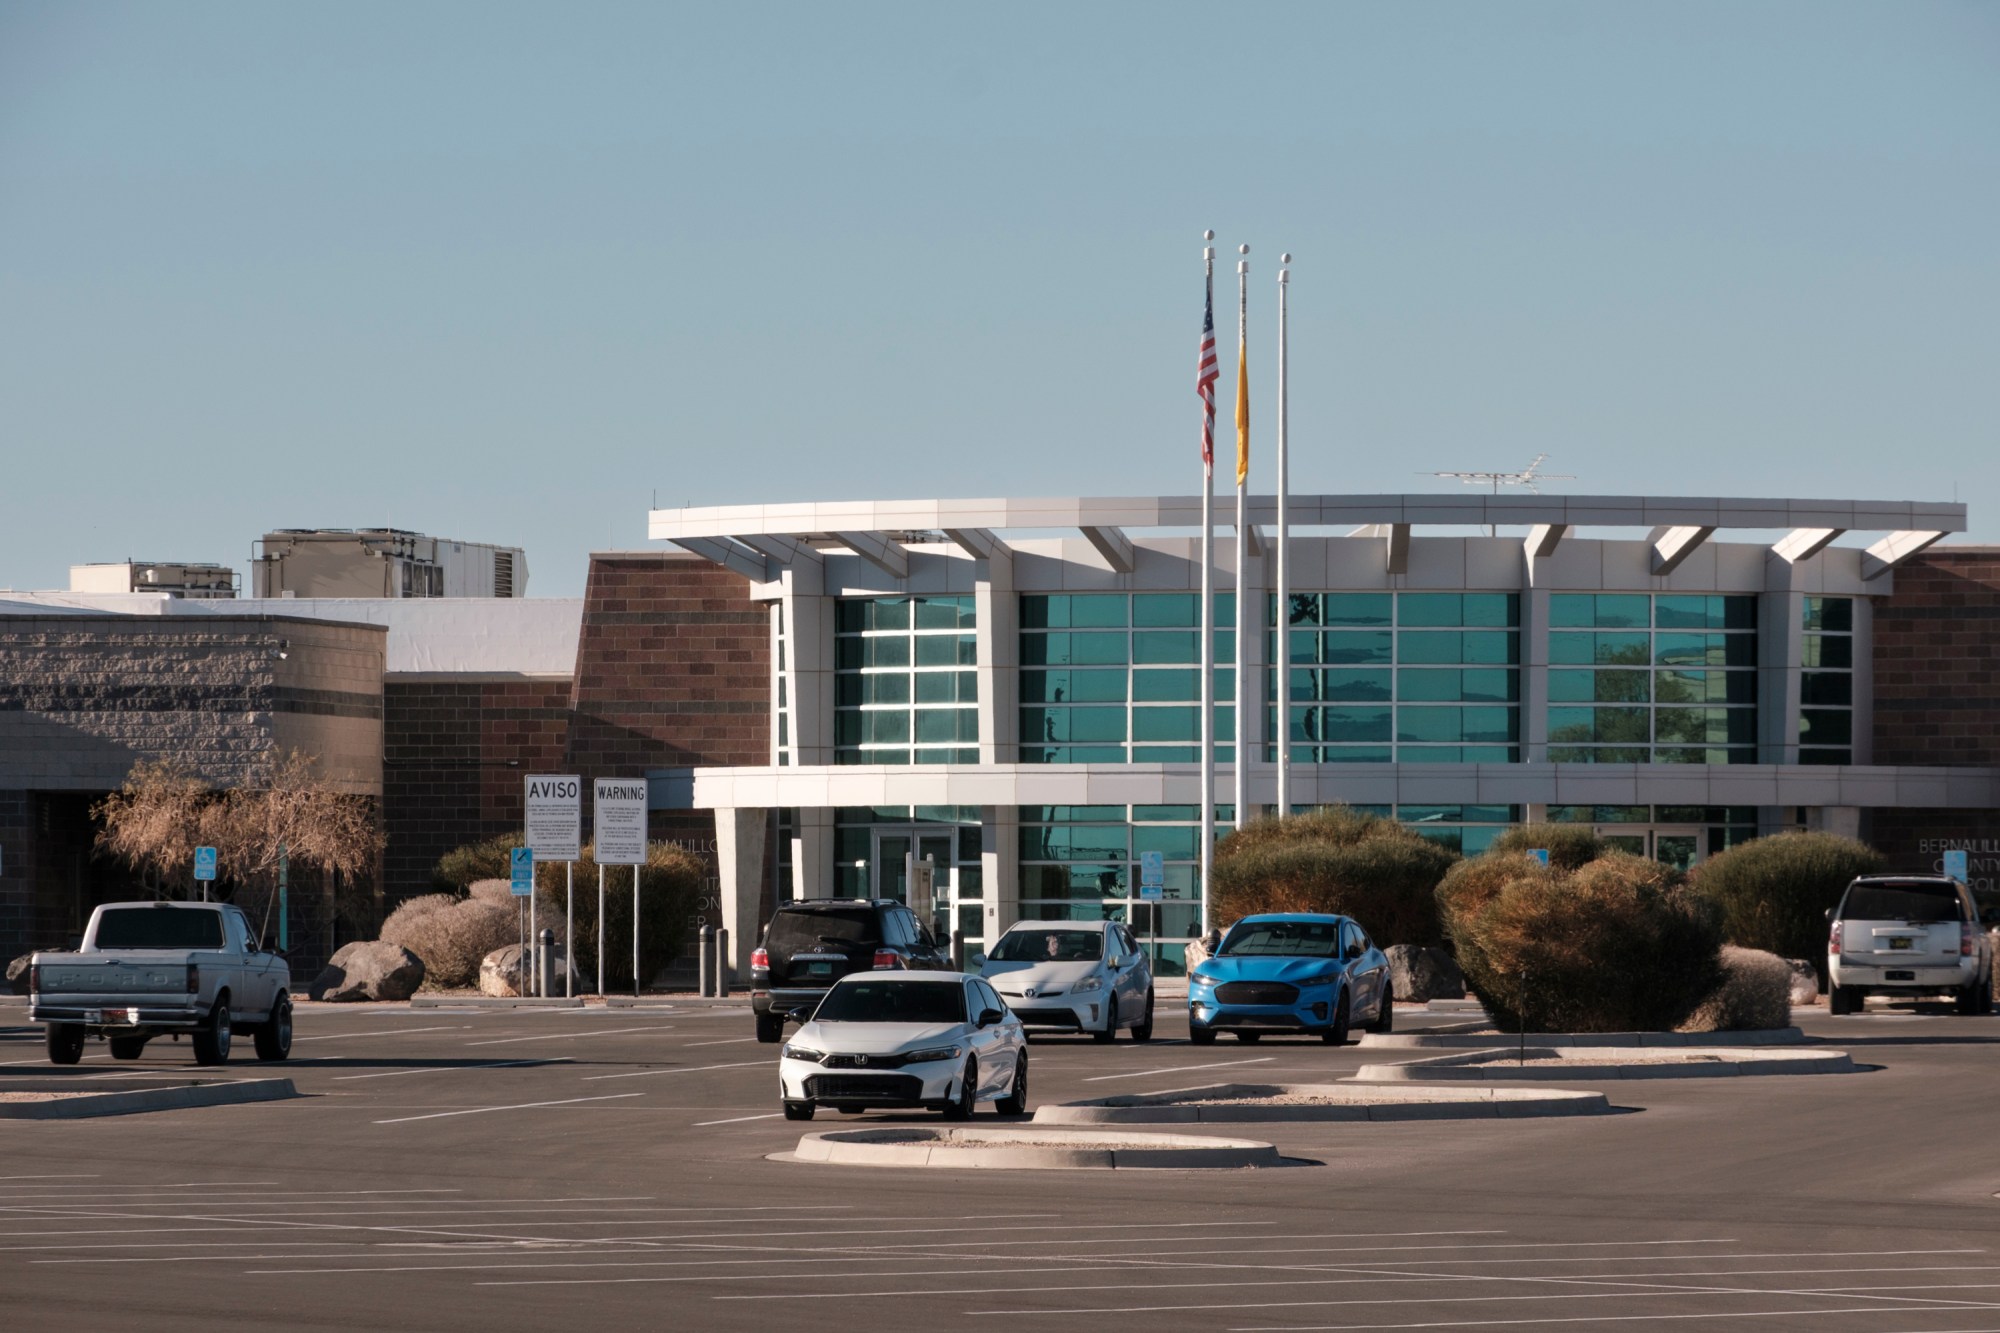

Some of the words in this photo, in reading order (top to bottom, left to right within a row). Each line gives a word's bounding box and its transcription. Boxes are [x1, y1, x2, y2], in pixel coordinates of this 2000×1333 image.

[529, 781, 577, 798] AVISO
[597, 786, 644, 800] WARNING
[1933, 858, 2000, 873] CUNTY
[60, 974, 168, 985] FORD
